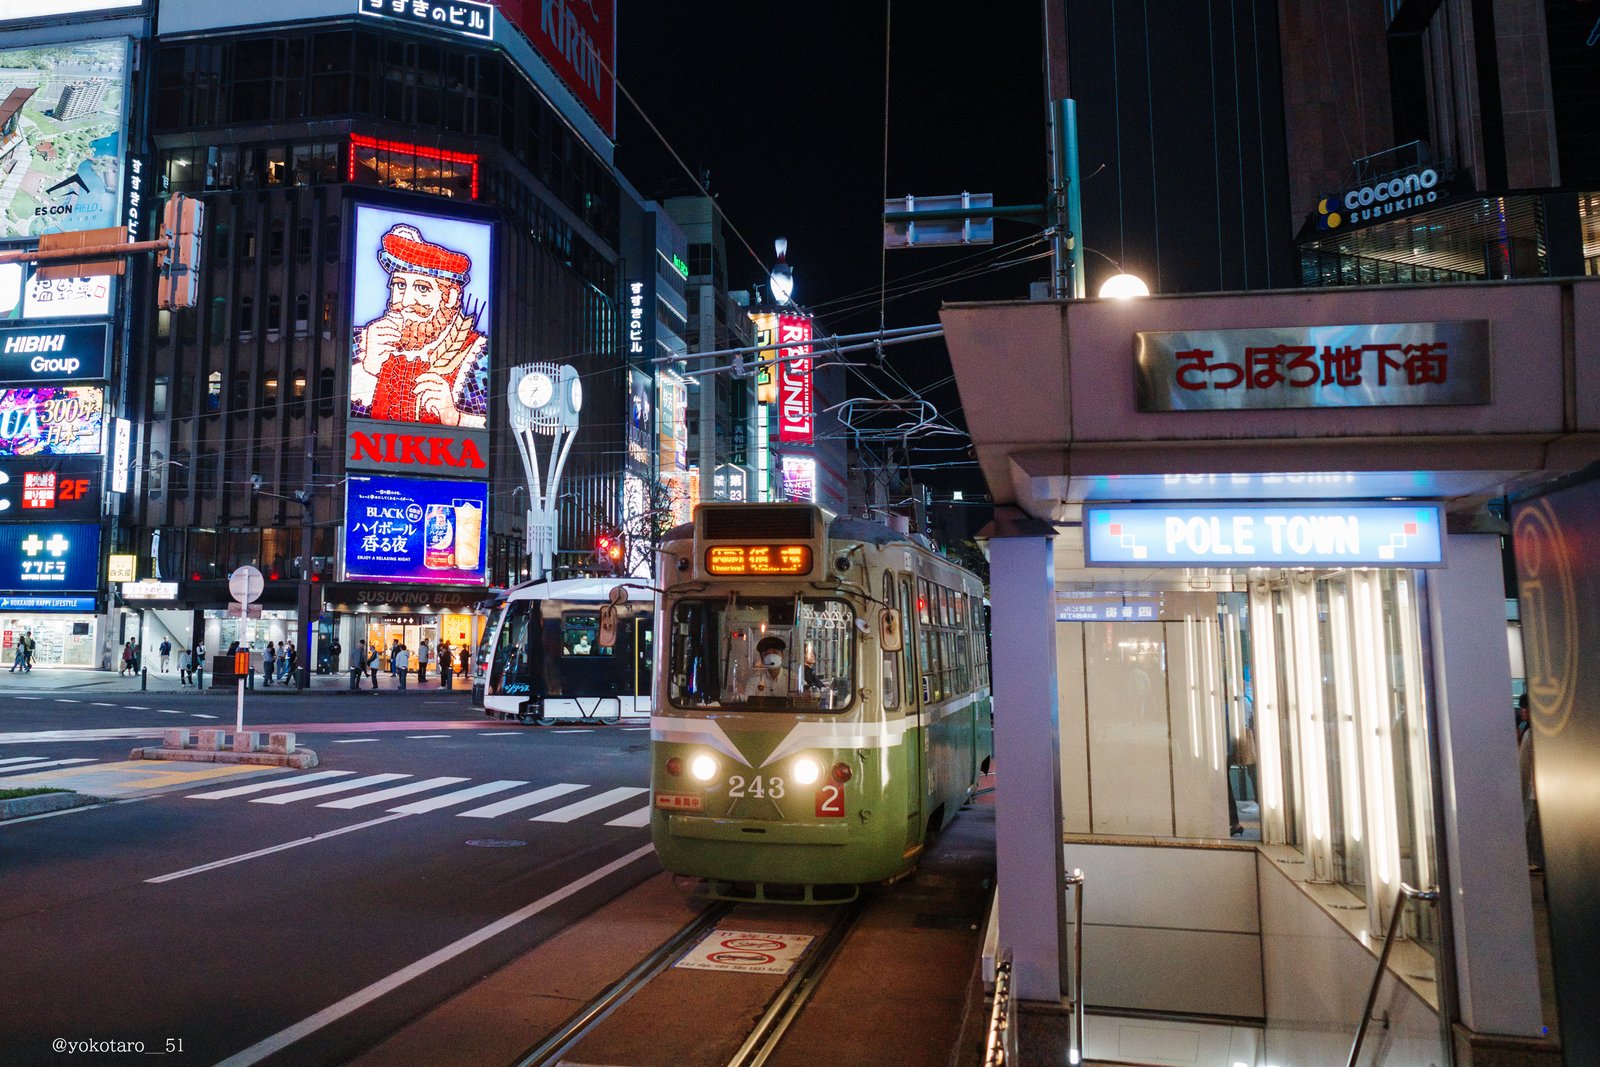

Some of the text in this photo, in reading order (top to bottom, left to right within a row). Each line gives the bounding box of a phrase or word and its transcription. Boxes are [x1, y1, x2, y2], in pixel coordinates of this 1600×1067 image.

[541, 0, 601, 102] KIRIN
[1350, 191, 1437, 224] SUSUKINO
[4, 335, 65, 353] HIBIKI
[31, 356, 80, 374] Group
[1175, 342, 1448, 391] さっぽろ地下街
[46, 424, 94, 447] 日本一
[350, 431, 487, 469] NIKKA
[59, 479, 89, 500] 2F
[366, 506, 405, 519] BLACK
[352, 520, 417, 536] ハイボール
[1165, 515, 1360, 555] POLE TOWN
[361, 535, 408, 553] 香る夜
[52, 599, 78, 607] LIFESTYLE
[357, 590, 429, 604] SUSUKINO
[728, 775, 786, 800] 243
[821, 785, 840, 812] 2
